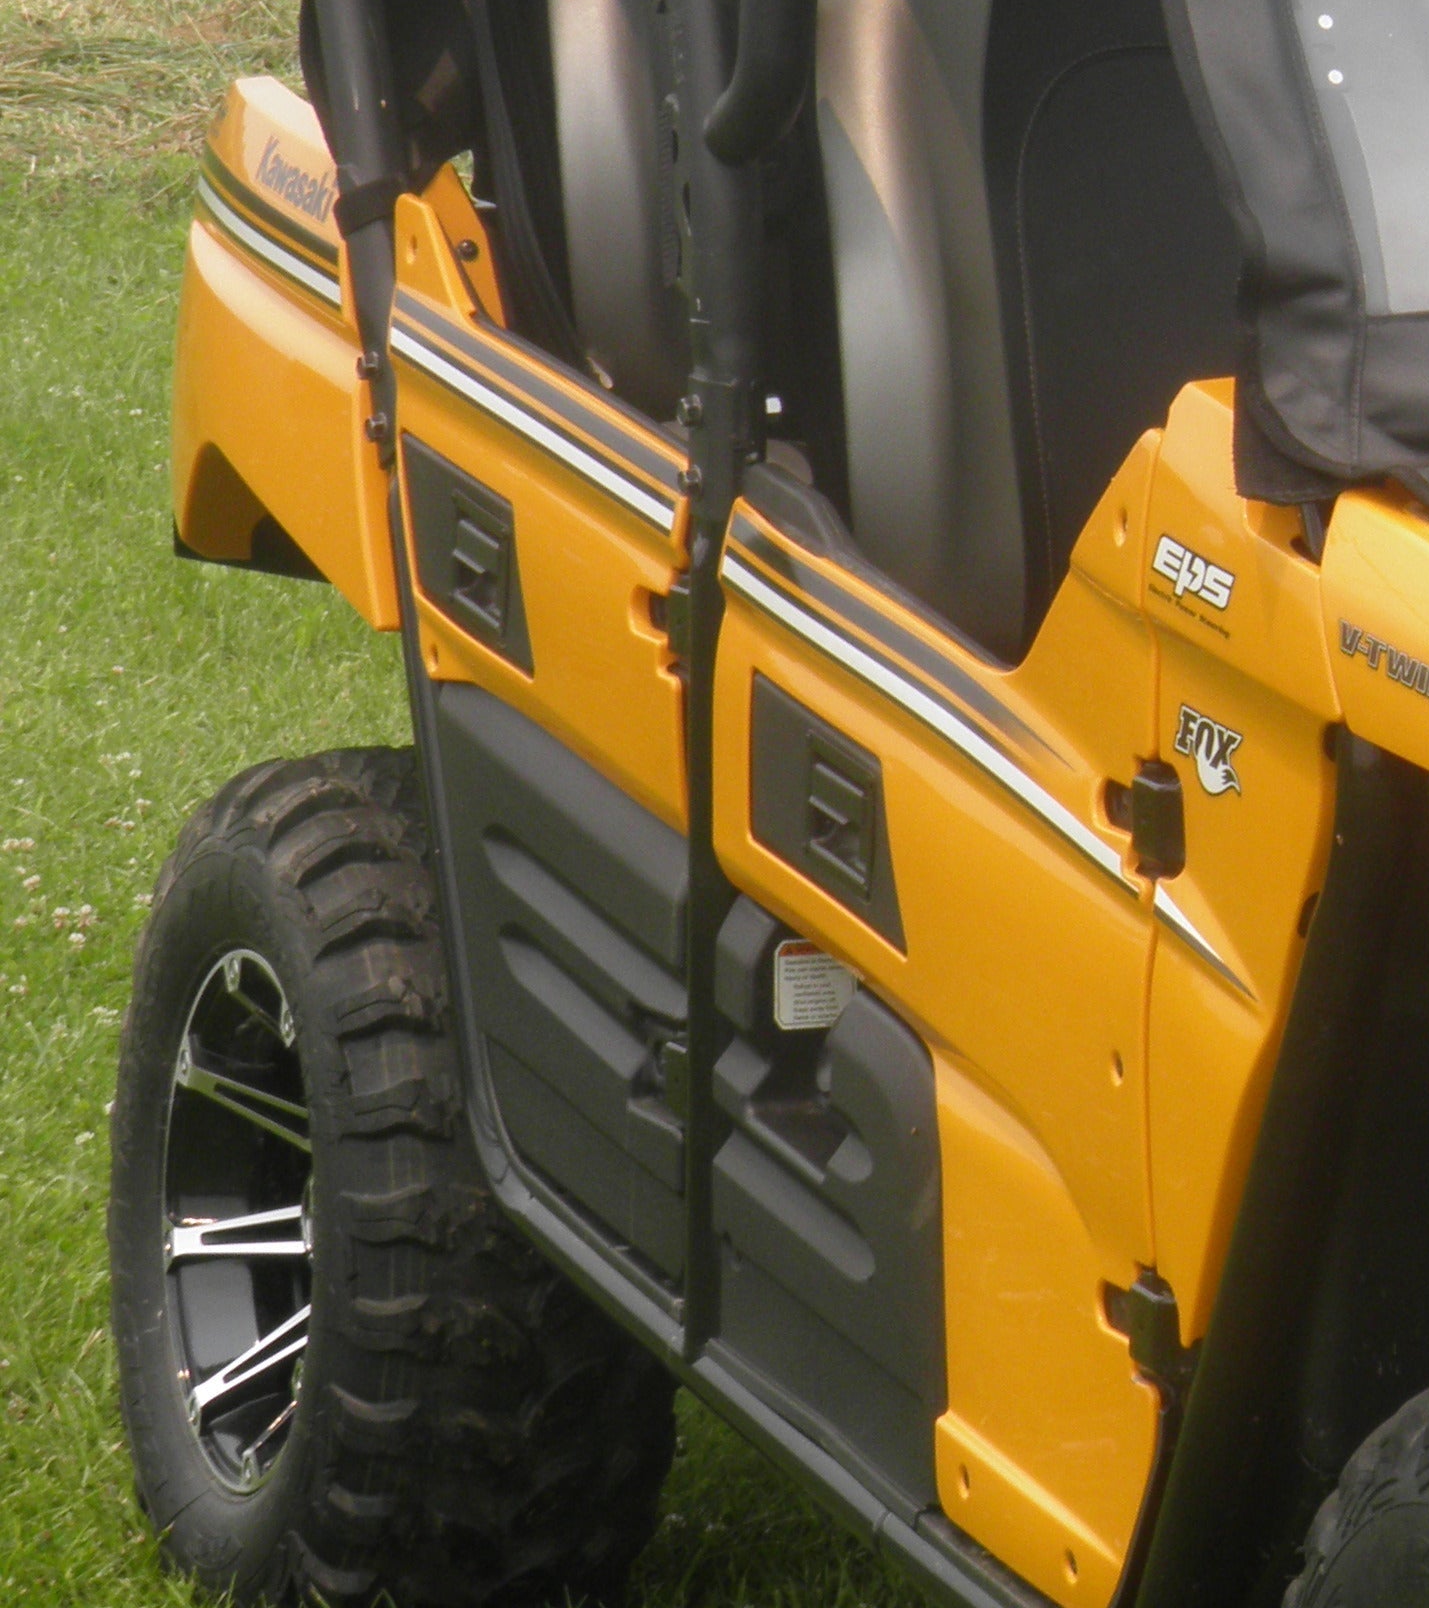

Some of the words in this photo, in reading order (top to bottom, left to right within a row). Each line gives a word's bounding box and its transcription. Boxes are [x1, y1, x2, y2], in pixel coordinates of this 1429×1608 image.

[256, 136, 338, 222] Kawasaki
[1153, 535, 1235, 610] EPS
[1176, 705, 1243, 770] FOX
